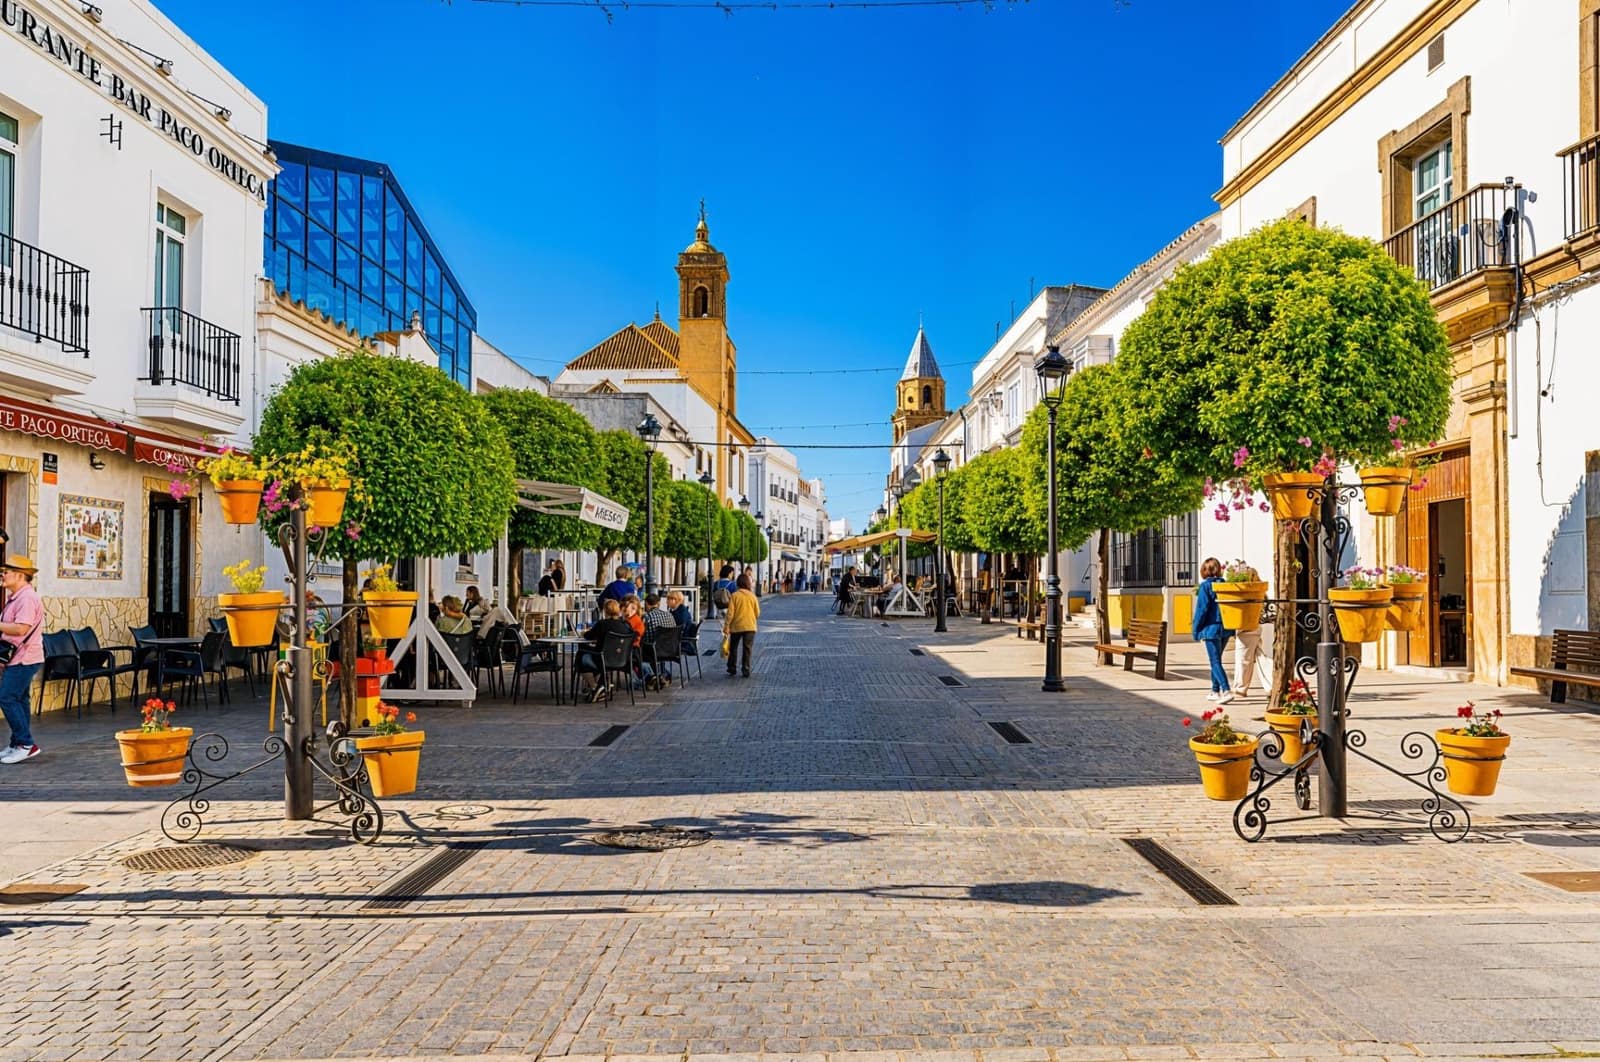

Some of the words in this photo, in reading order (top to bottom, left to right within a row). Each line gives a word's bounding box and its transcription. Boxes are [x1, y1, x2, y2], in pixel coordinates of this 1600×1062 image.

[1, 0, 102, 86] URANTE
[111, 73, 152, 122] BAR
[160, 108, 204, 156] PACO
[20, 414, 57, 435] PACO
[61, 423, 113, 447] ORTEGA
